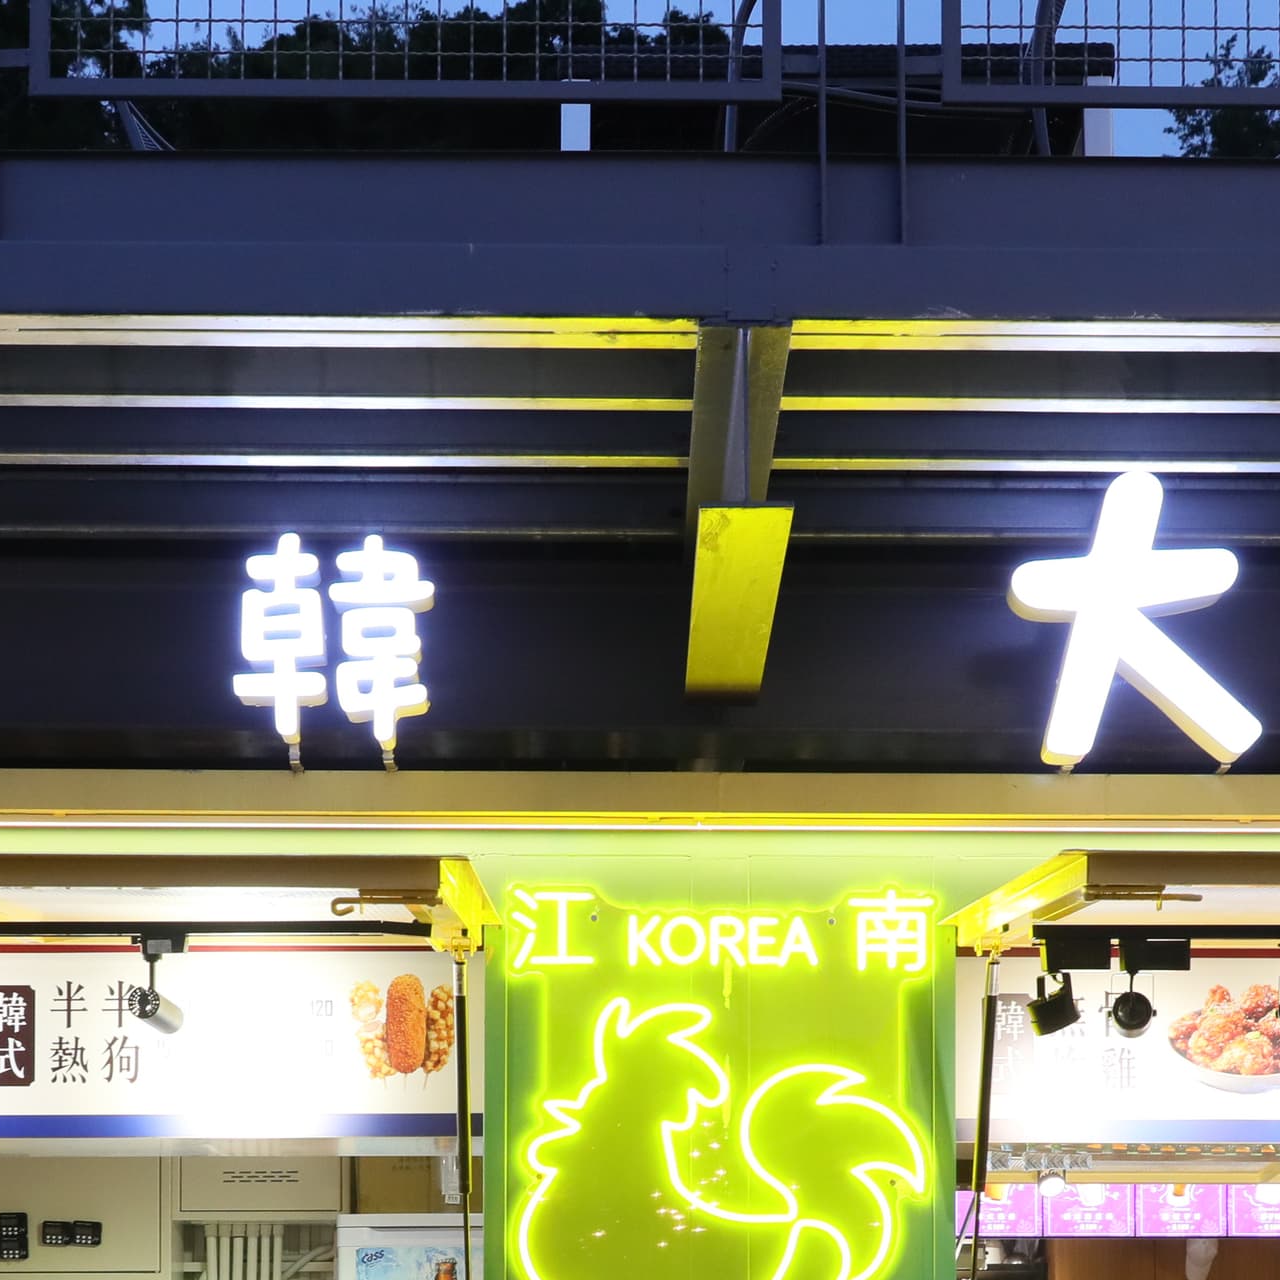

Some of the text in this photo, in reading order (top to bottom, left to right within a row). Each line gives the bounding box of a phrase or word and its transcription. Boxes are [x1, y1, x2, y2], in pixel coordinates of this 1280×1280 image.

[512, 888, 596, 968] 江
[628, 914, 820, 968] KOREA
[847, 889, 935, 973] 南
[50, 1036, 139, 1083] 熱狗
[361, 1249, 385, 1264] Cass
